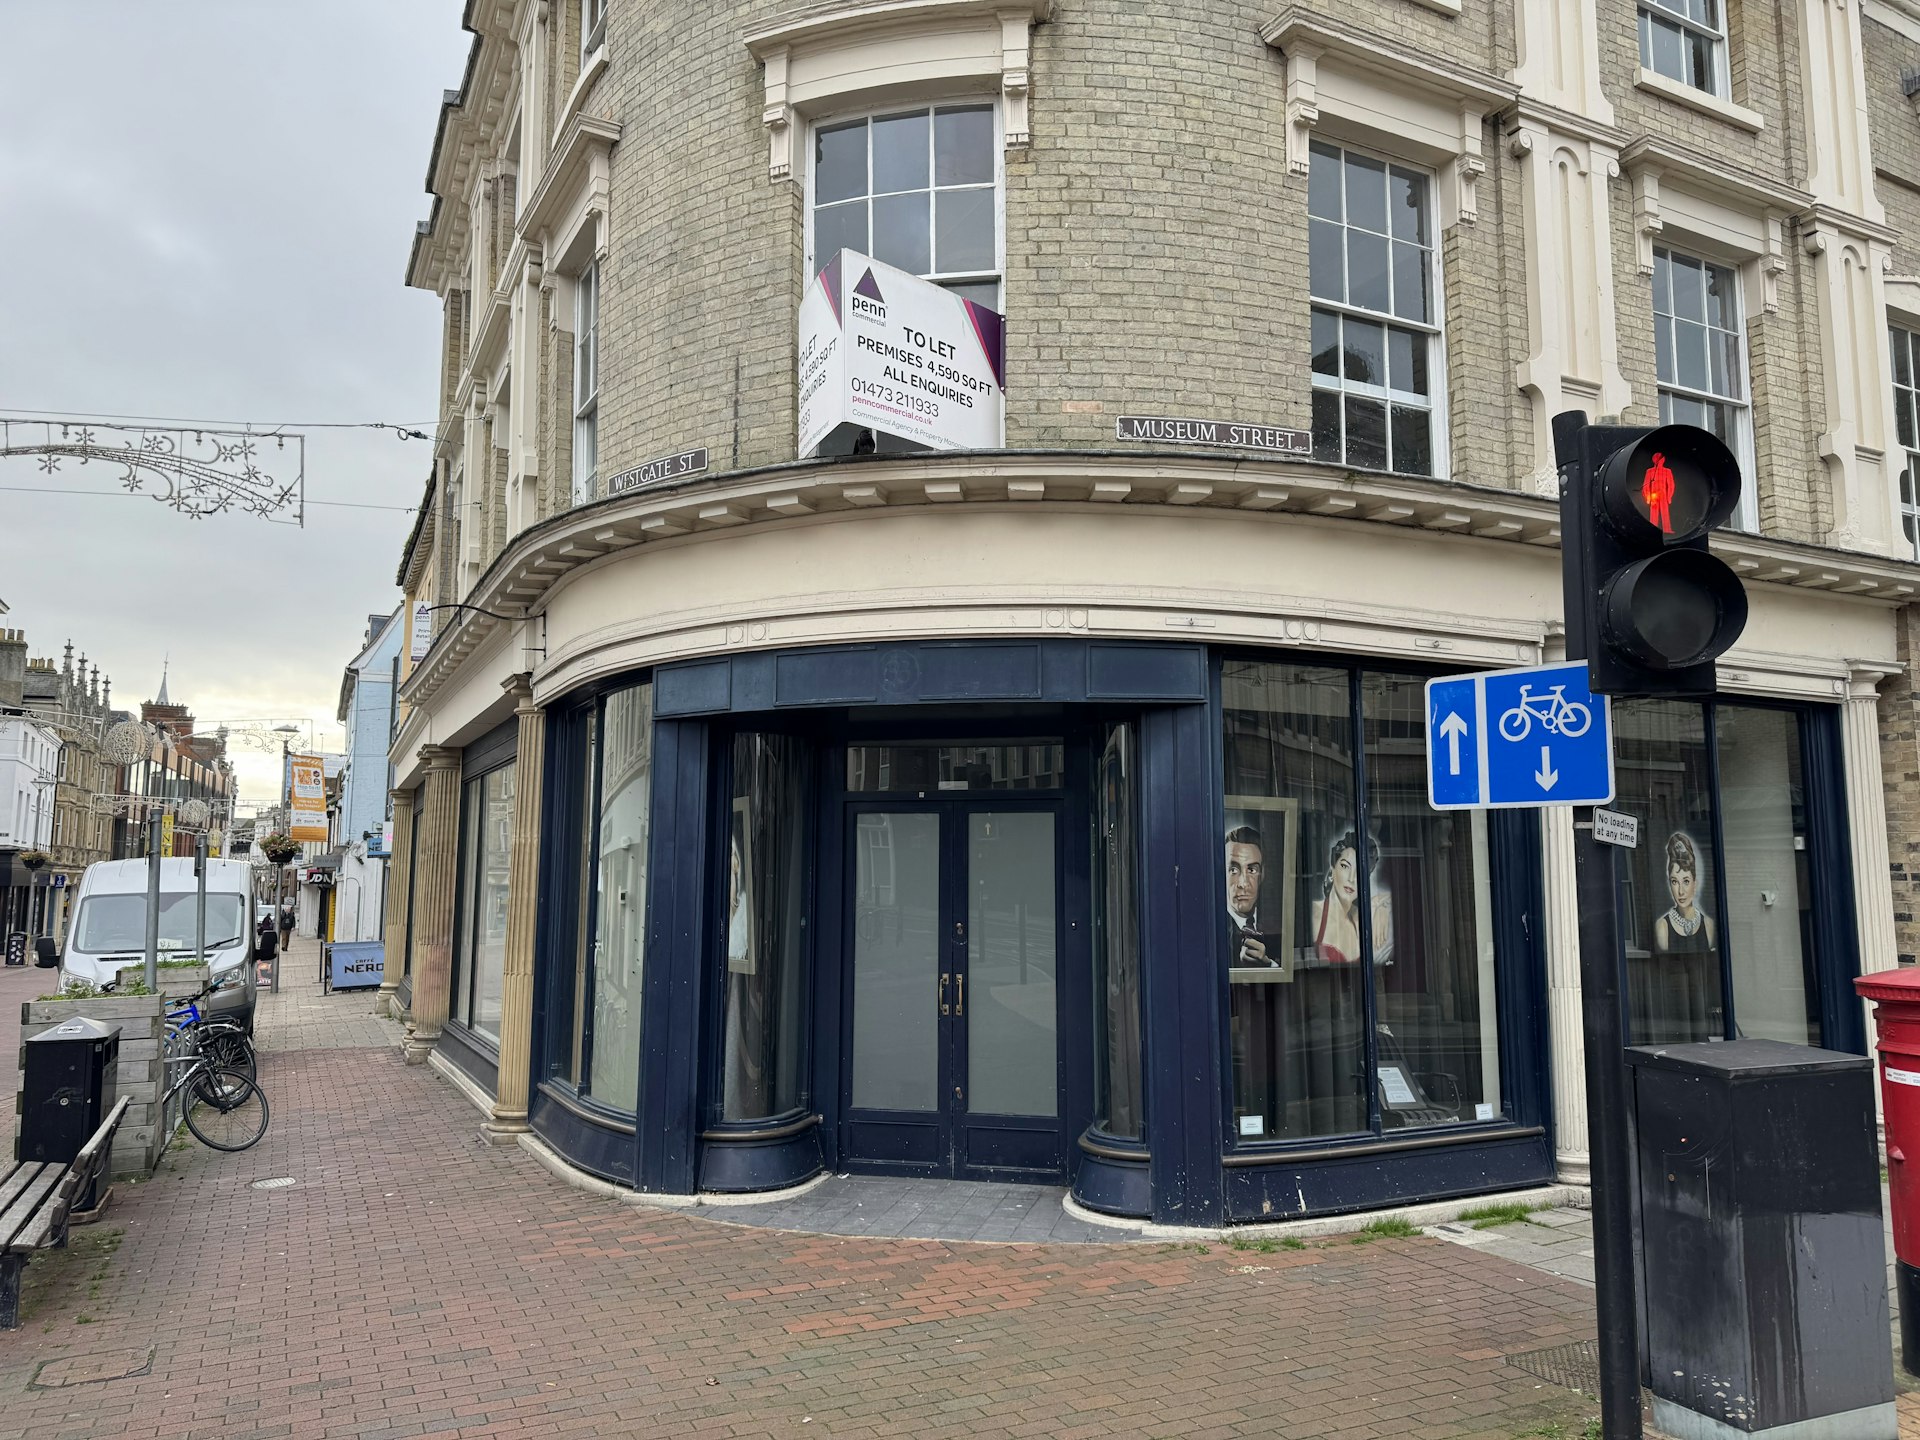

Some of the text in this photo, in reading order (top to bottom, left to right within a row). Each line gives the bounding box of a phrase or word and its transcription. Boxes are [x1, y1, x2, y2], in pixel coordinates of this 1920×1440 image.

[852, 296, 886, 319] penn
[852, 311, 887, 328] commercial
[805, 333, 817, 360] LET
[829, 336, 837, 356] FT
[903, 326, 956, 360] TO LET
[857, 335, 992, 396] PREMISES 4,590 SQ FT
[851, 377, 939, 418] 01473 211933
[883, 365, 973, 408] ALL ENQUIRIES
[852, 395, 933, 426] penncommercial.co.uk
[852, 408, 891, 426] Commercial
[892, 420, 913, 434] Agency
[920, 428, 943, 444] Property
[1132, 419, 1295, 449] MUSEUM STREET
[679, 453, 695, 472] ST
[1597, 826, 1635, 843] at any time
[1599, 813, 1634, 832] No loading
[309, 873, 323, 883] JD
[344, 963, 384, 974] NERO
